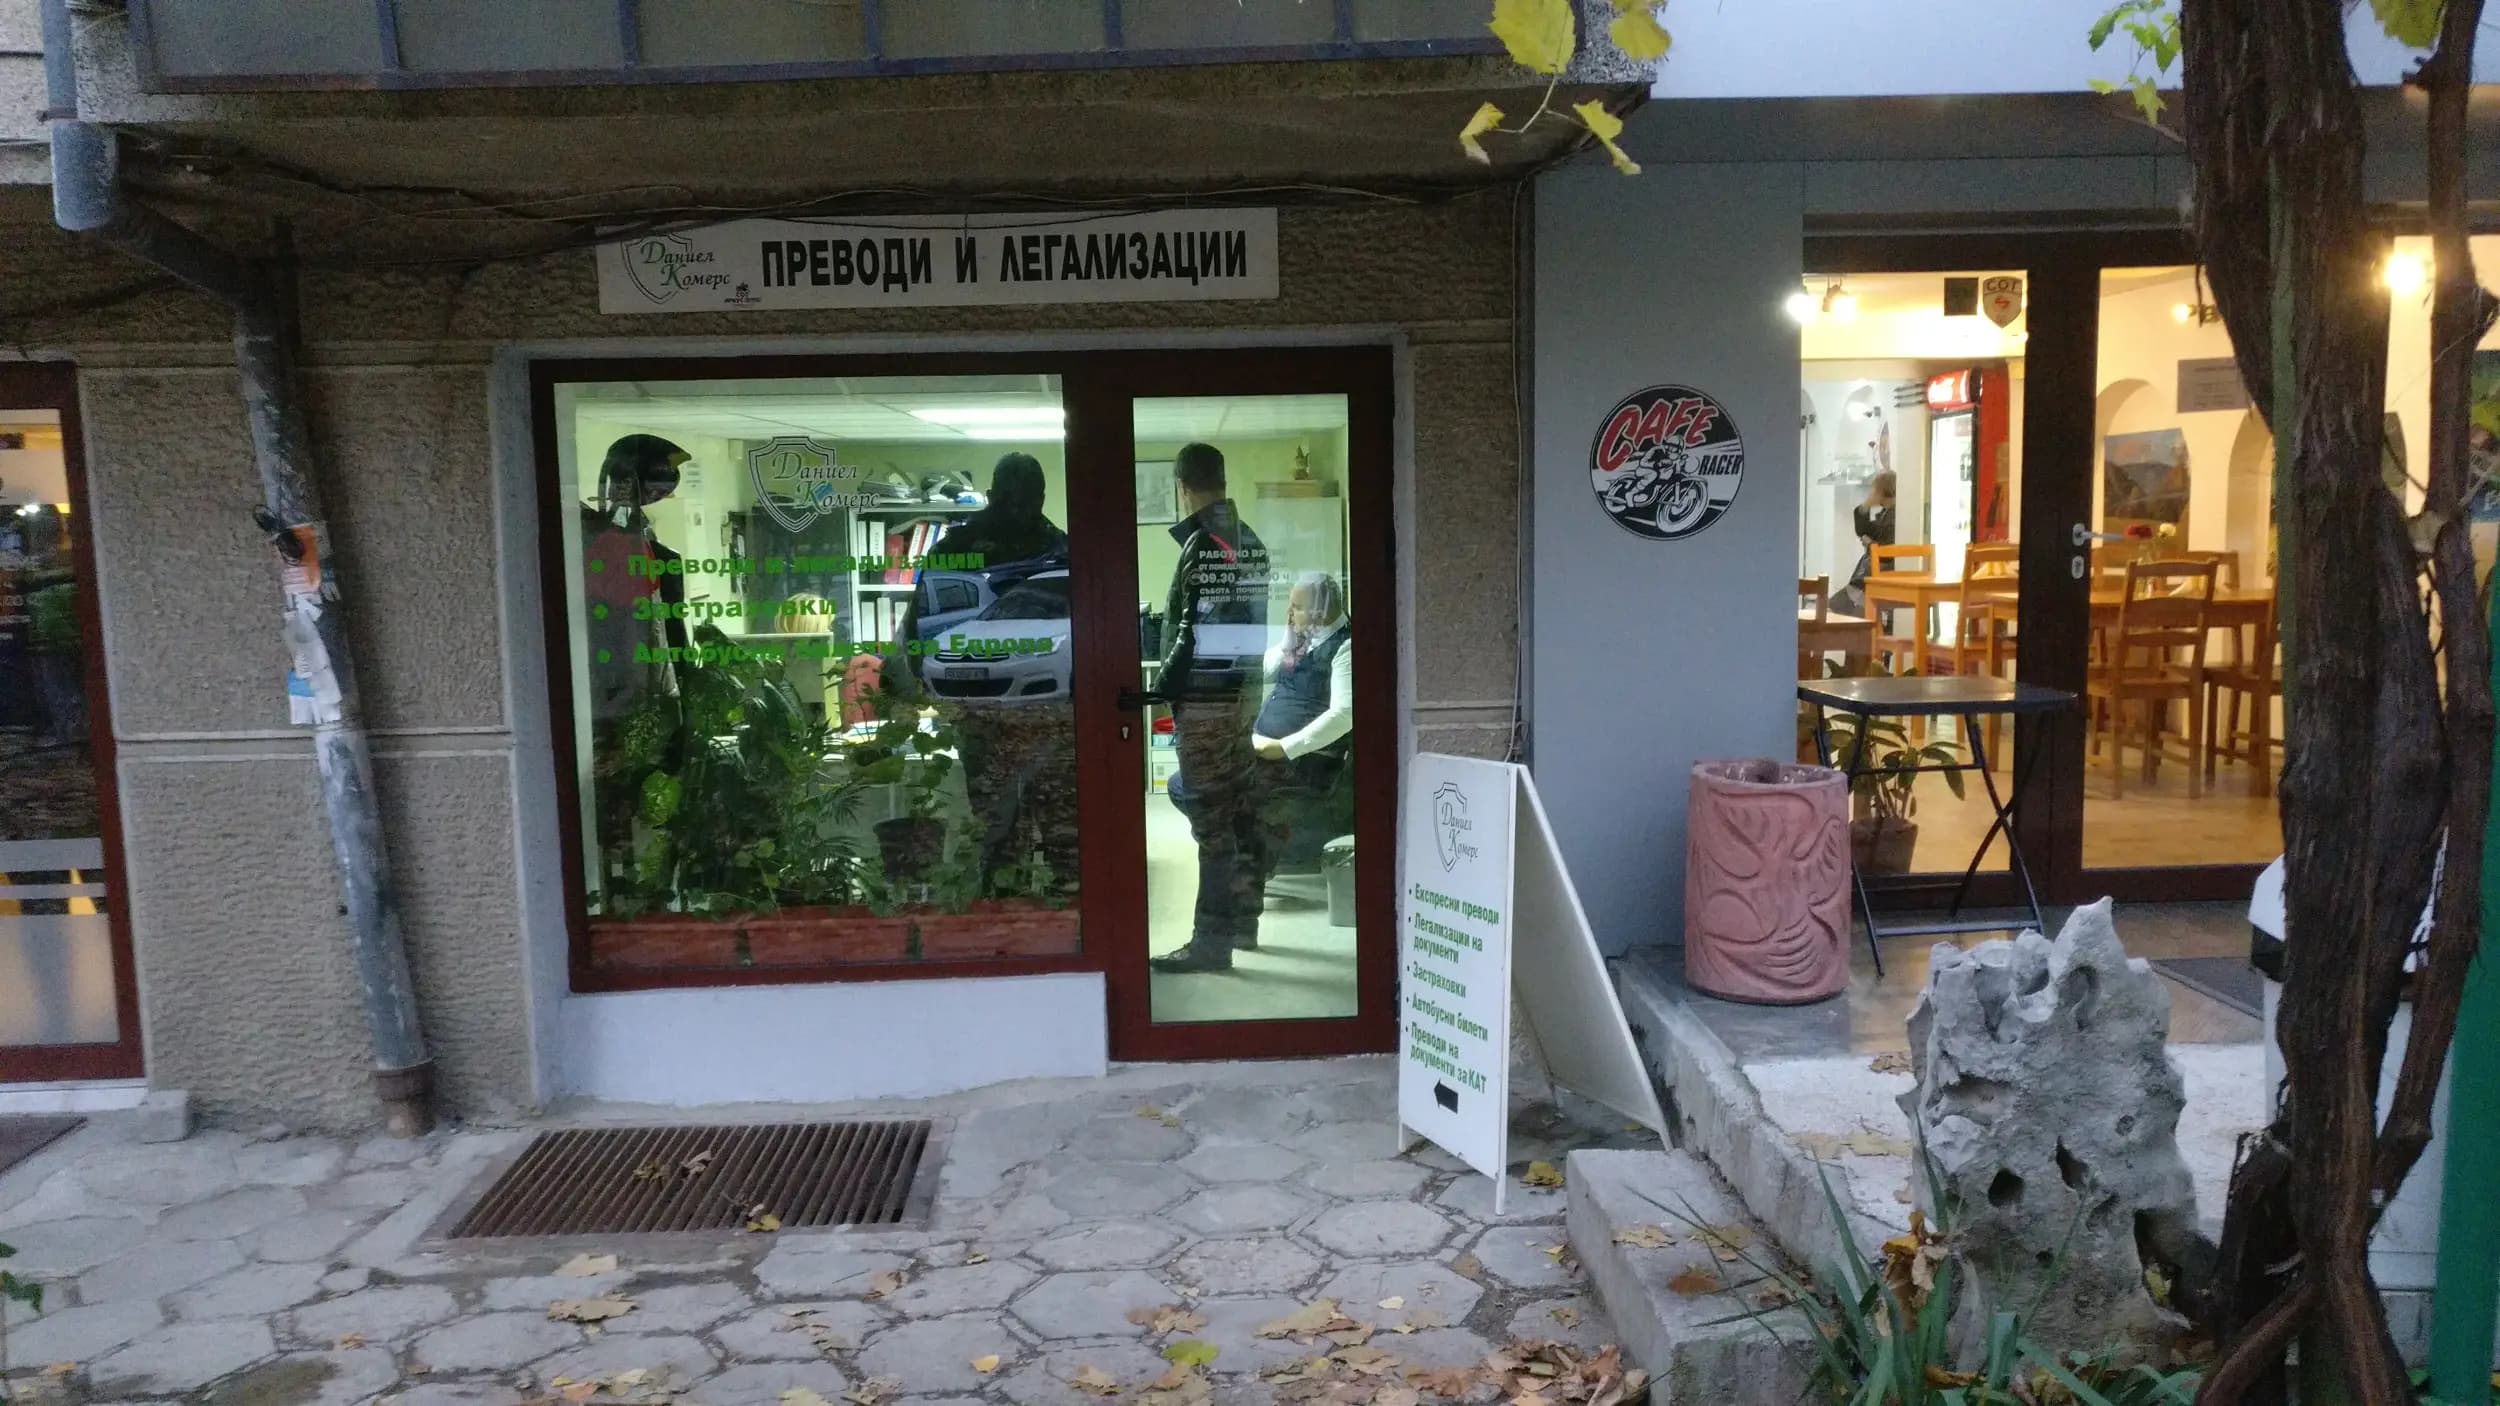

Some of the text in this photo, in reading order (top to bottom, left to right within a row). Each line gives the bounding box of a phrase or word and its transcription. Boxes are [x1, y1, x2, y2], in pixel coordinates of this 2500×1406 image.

[640, 240, 716, 265] Даниел
[761, 230, 1247, 293] ПРЕВОДИ И ЛЕГАЛИЗАЦИИ
[660, 262, 731, 291] Комерс
[1597, 397, 1719, 472] CAFE
[771, 450, 857, 480] Даниел
[1698, 453, 1743, 476] RACER
[793, 480, 880, 514] Комерс
[628, 555, 755, 582] Преводи
[950, 634, 1055, 660] Европа
[1441, 802, 1472, 831] Даниел
[1448, 828, 1479, 862] Комерс
[1415, 882, 1500, 927] Експресни преводи
[1413, 935, 1459, 963] документи
[1414, 912, 1483, 952] Легализации на
[1413, 960, 1466, 998] Застраховки
[1412, 992, 1488, 1042] Автобусни билети
[1411, 1021, 1459, 1059] Преводи на
[1410, 1044, 1455, 1078] документи
